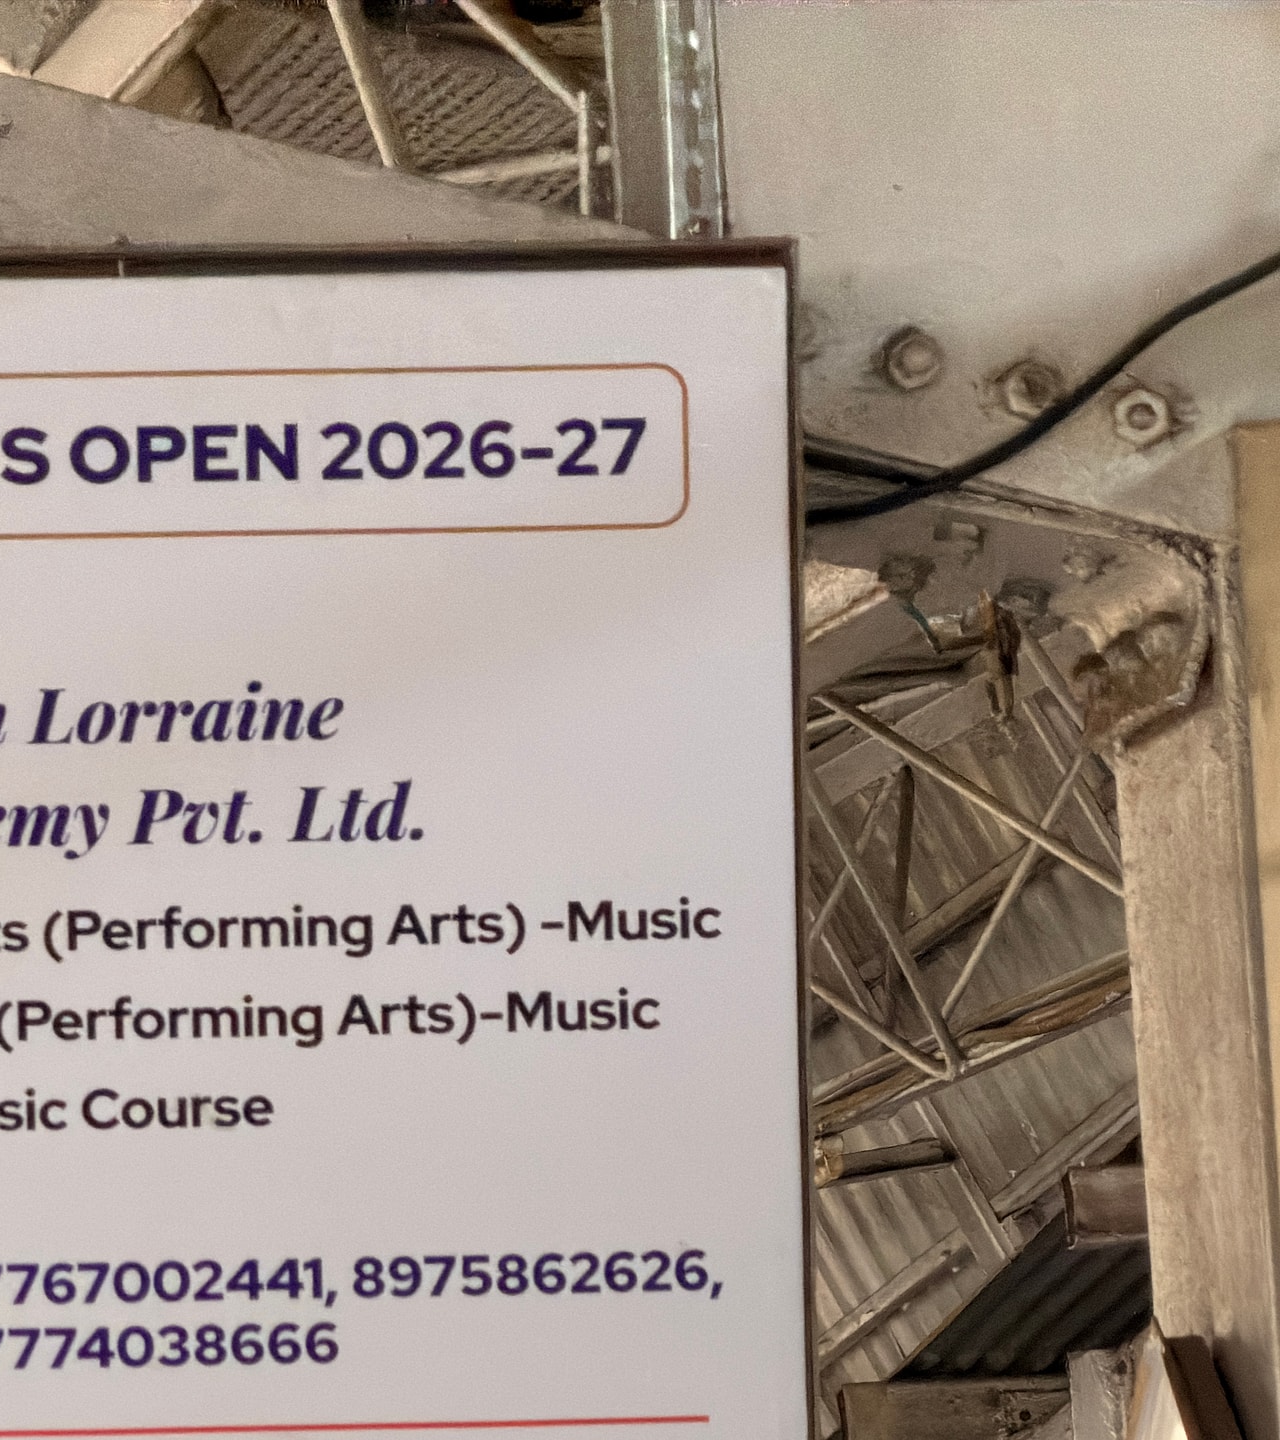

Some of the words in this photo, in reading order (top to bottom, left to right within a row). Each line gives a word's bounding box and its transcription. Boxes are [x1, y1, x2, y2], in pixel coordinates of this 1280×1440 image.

[69, 423, 299, 485] OPEN
[319, 417, 647, 481] 2026-27
[27, 680, 344, 745] Lorraine
[128, 788, 263, 845] Pvt.
[287, 779, 424, 843] Ltd.
[43, 904, 374, 964] (Performing
[386, 902, 526, 955] Arts)
[81, 1087, 275, 1131] Course
[352, 1248, 723, 1300] 8975862626,
